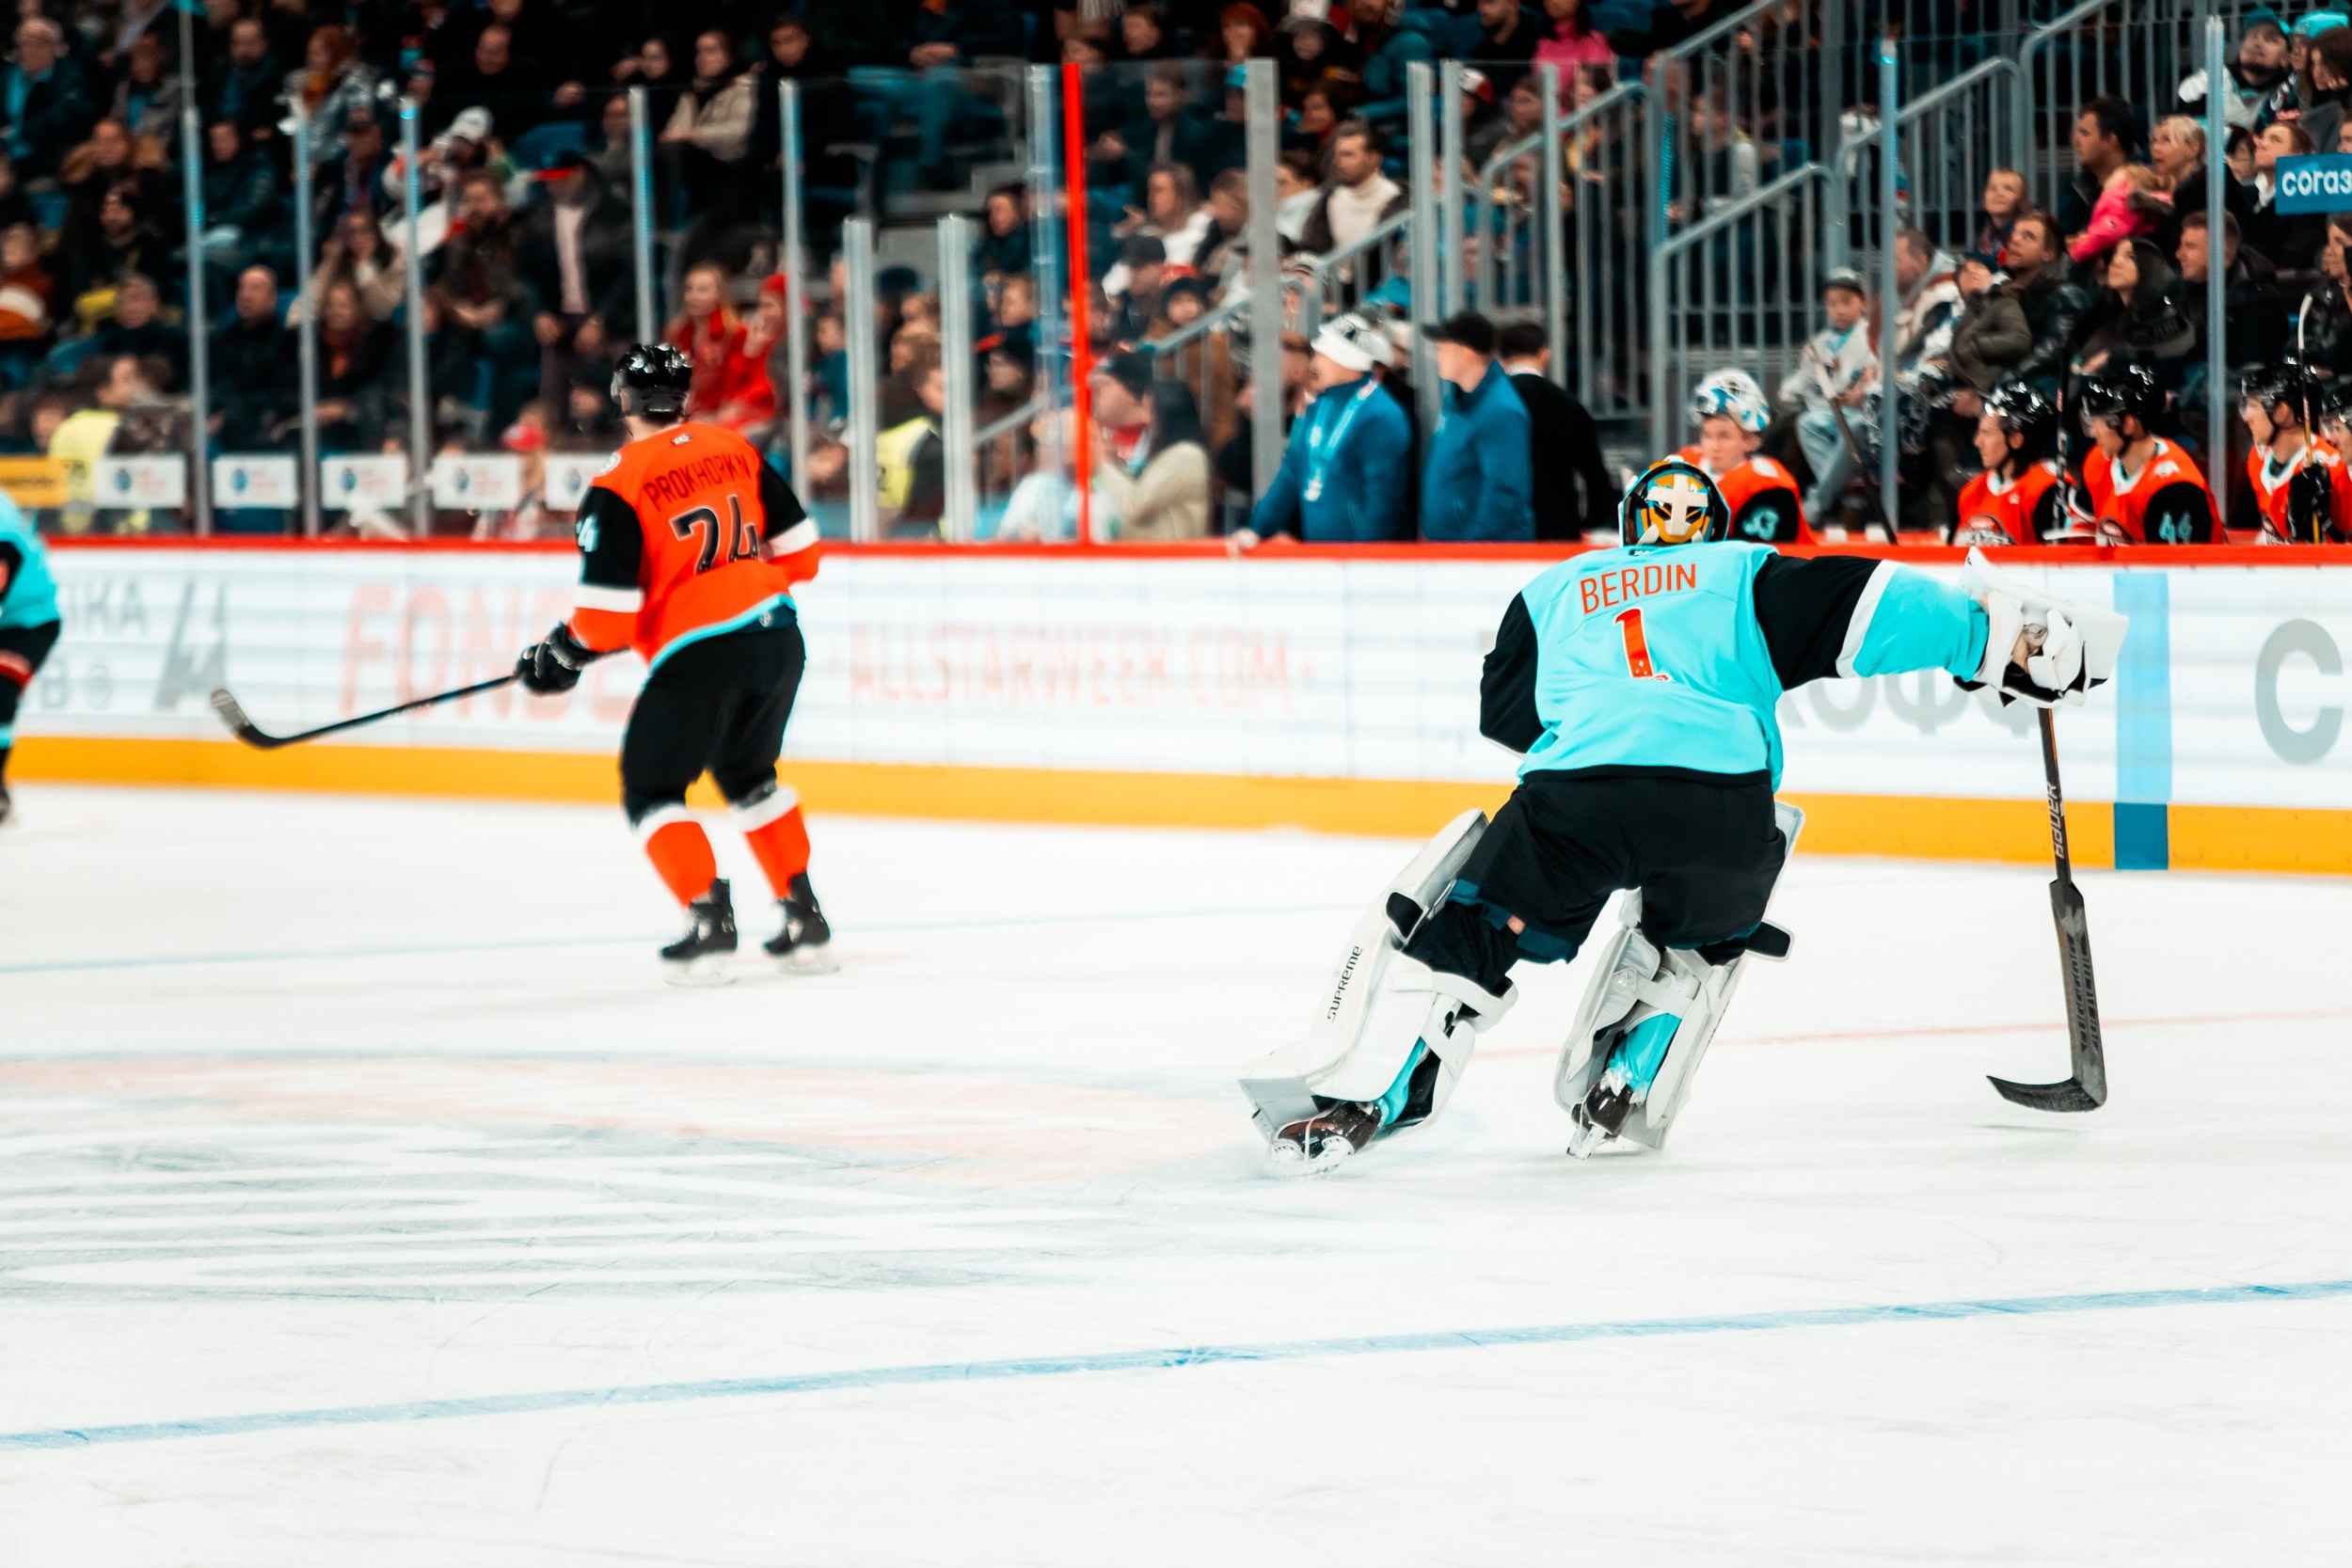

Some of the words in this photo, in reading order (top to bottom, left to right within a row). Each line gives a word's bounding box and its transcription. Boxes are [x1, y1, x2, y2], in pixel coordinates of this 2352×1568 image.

[669, 494, 760, 574] 74
[1580, 562, 1696, 614] BERDIN
[1613, 609, 1654, 678] 1
[2046, 782, 2065, 860] BAUER
